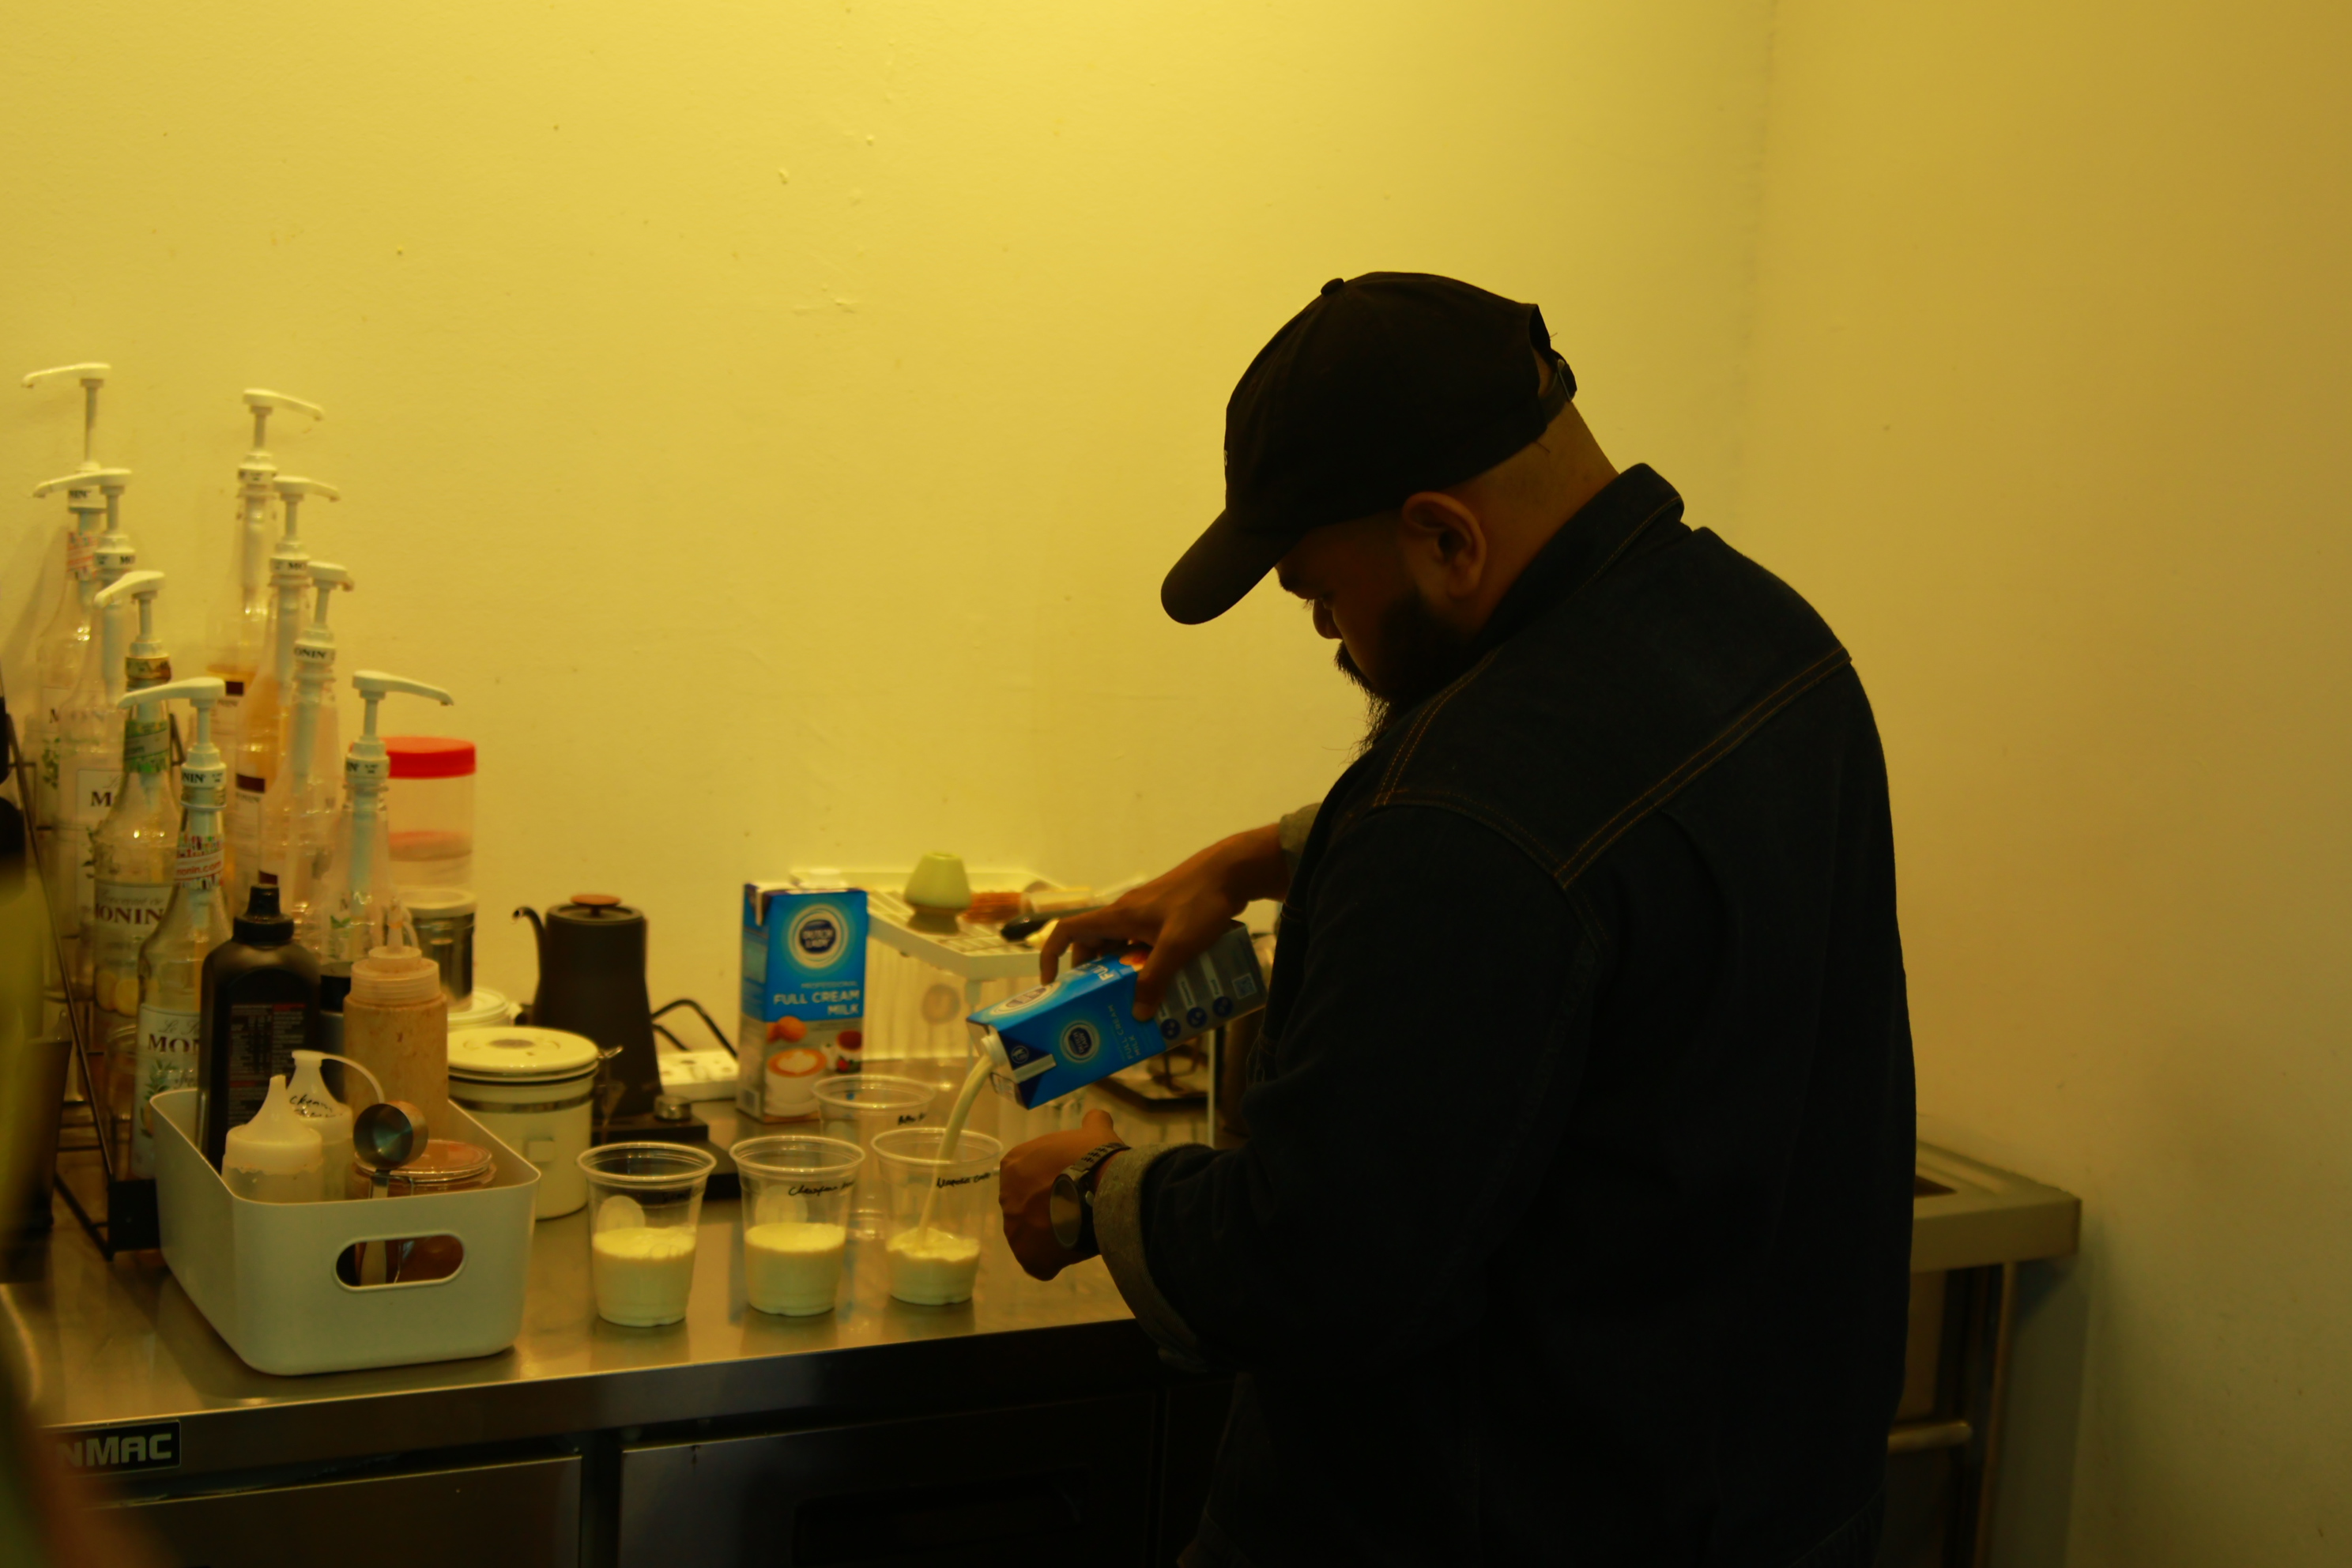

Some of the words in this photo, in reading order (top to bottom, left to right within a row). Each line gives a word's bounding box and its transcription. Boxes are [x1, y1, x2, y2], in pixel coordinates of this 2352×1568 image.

[182, 771, 205, 783] NIN
[772, 992, 808, 1005] FULL
[811, 989, 861, 1004] CREAM
[827, 1003, 860, 1016] MILK
[1107, 1004, 1125, 1036] CREAM
[1121, 1036, 1134, 1060] FULL
[1128, 1035, 1141, 1057] MILK
